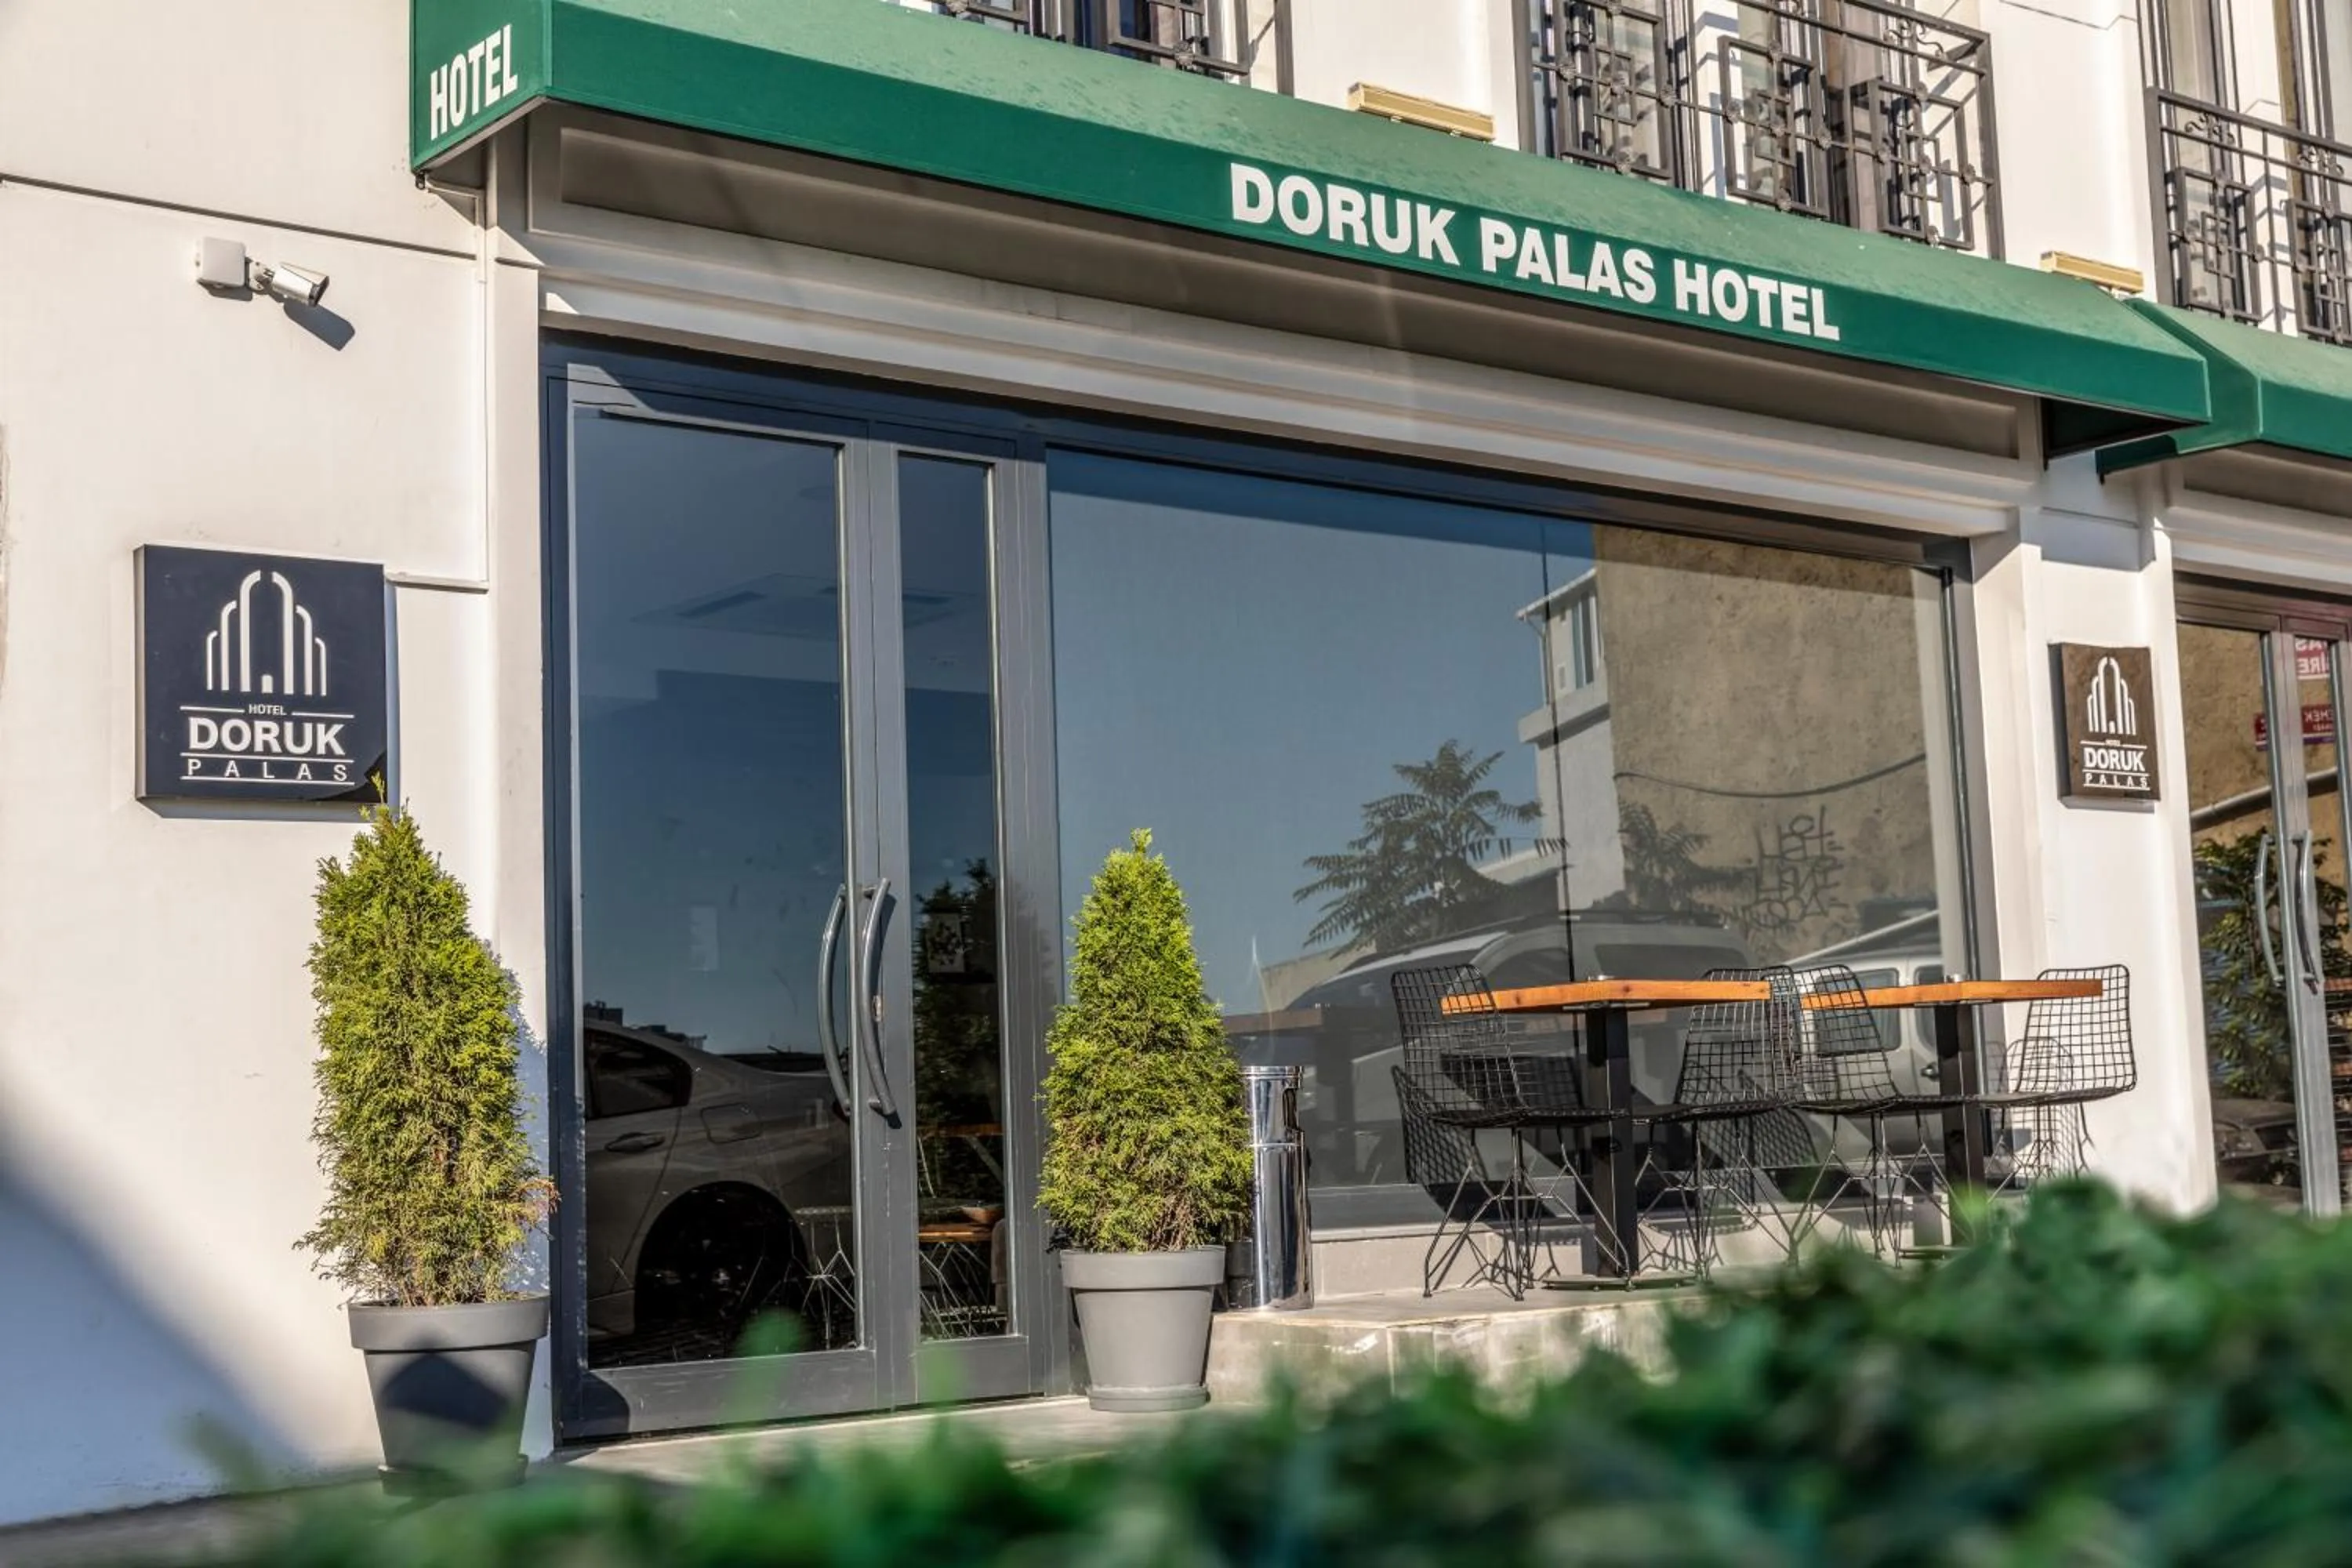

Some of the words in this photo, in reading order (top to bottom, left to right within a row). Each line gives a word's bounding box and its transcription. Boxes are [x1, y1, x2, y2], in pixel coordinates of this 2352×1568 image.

[430, 24, 517, 141] HOTEL
[1230, 162, 1460, 266] DORUK
[1479, 217, 1657, 303] PALAS
[1673, 258, 1840, 341] HOTEL
[248, 704, 287, 716] HOTEL
[188, 717, 346, 756] DORUK
[187, 758, 347, 782] PALAS
[2083, 747, 2146, 772] DORUK
[2085, 773, 2148, 788] PALAS
